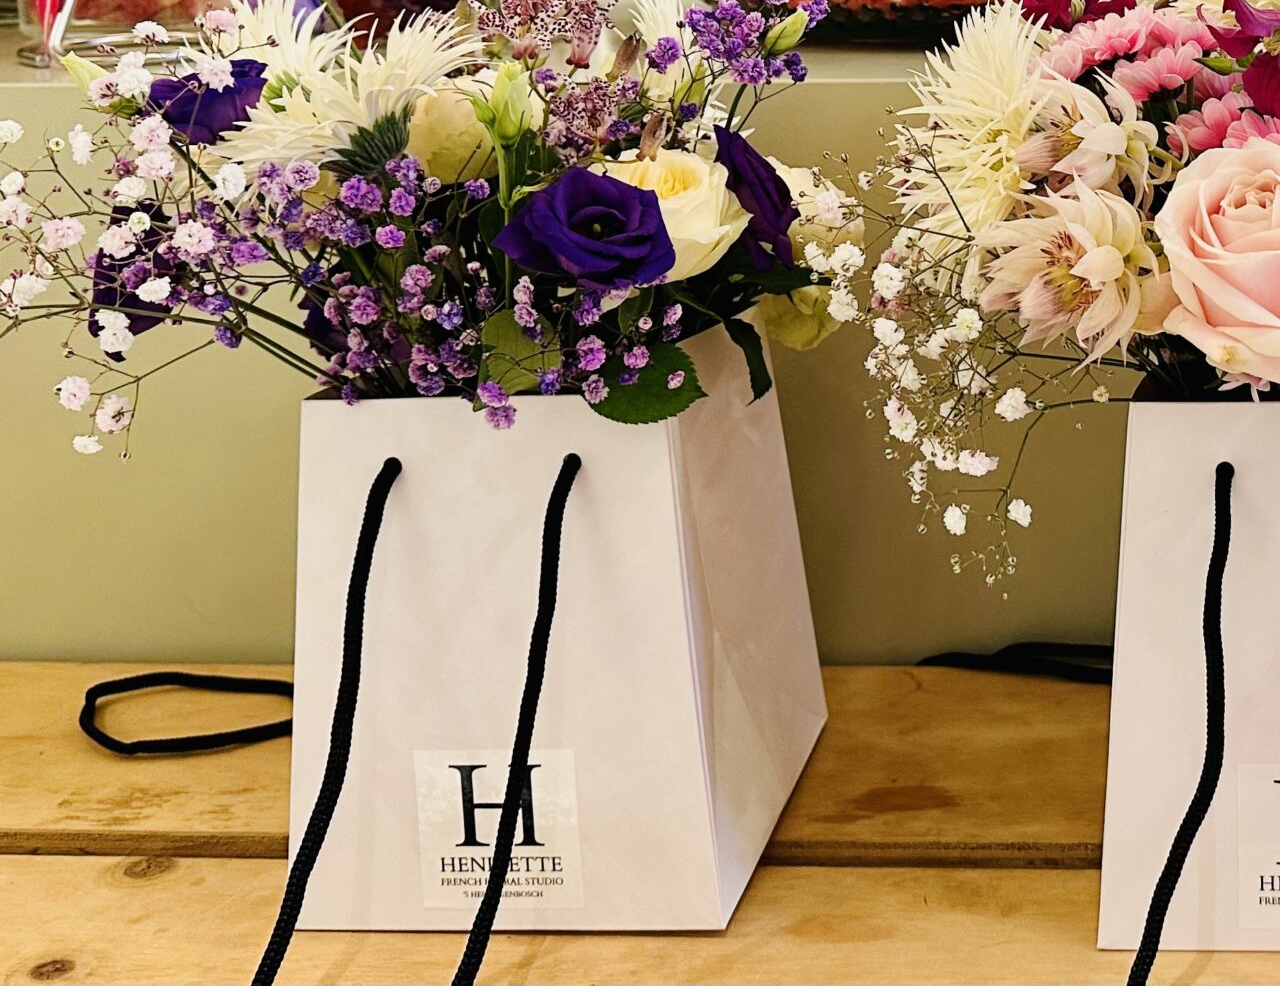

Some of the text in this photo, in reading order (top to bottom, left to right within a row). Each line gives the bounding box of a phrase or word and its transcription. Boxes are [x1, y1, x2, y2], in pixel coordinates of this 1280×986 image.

[448, 764, 545, 847] H
[440, 856, 563, 873] HENETTE
[441, 877, 481, 887] FRENCH
[525, 877, 564, 886] STUDIO
